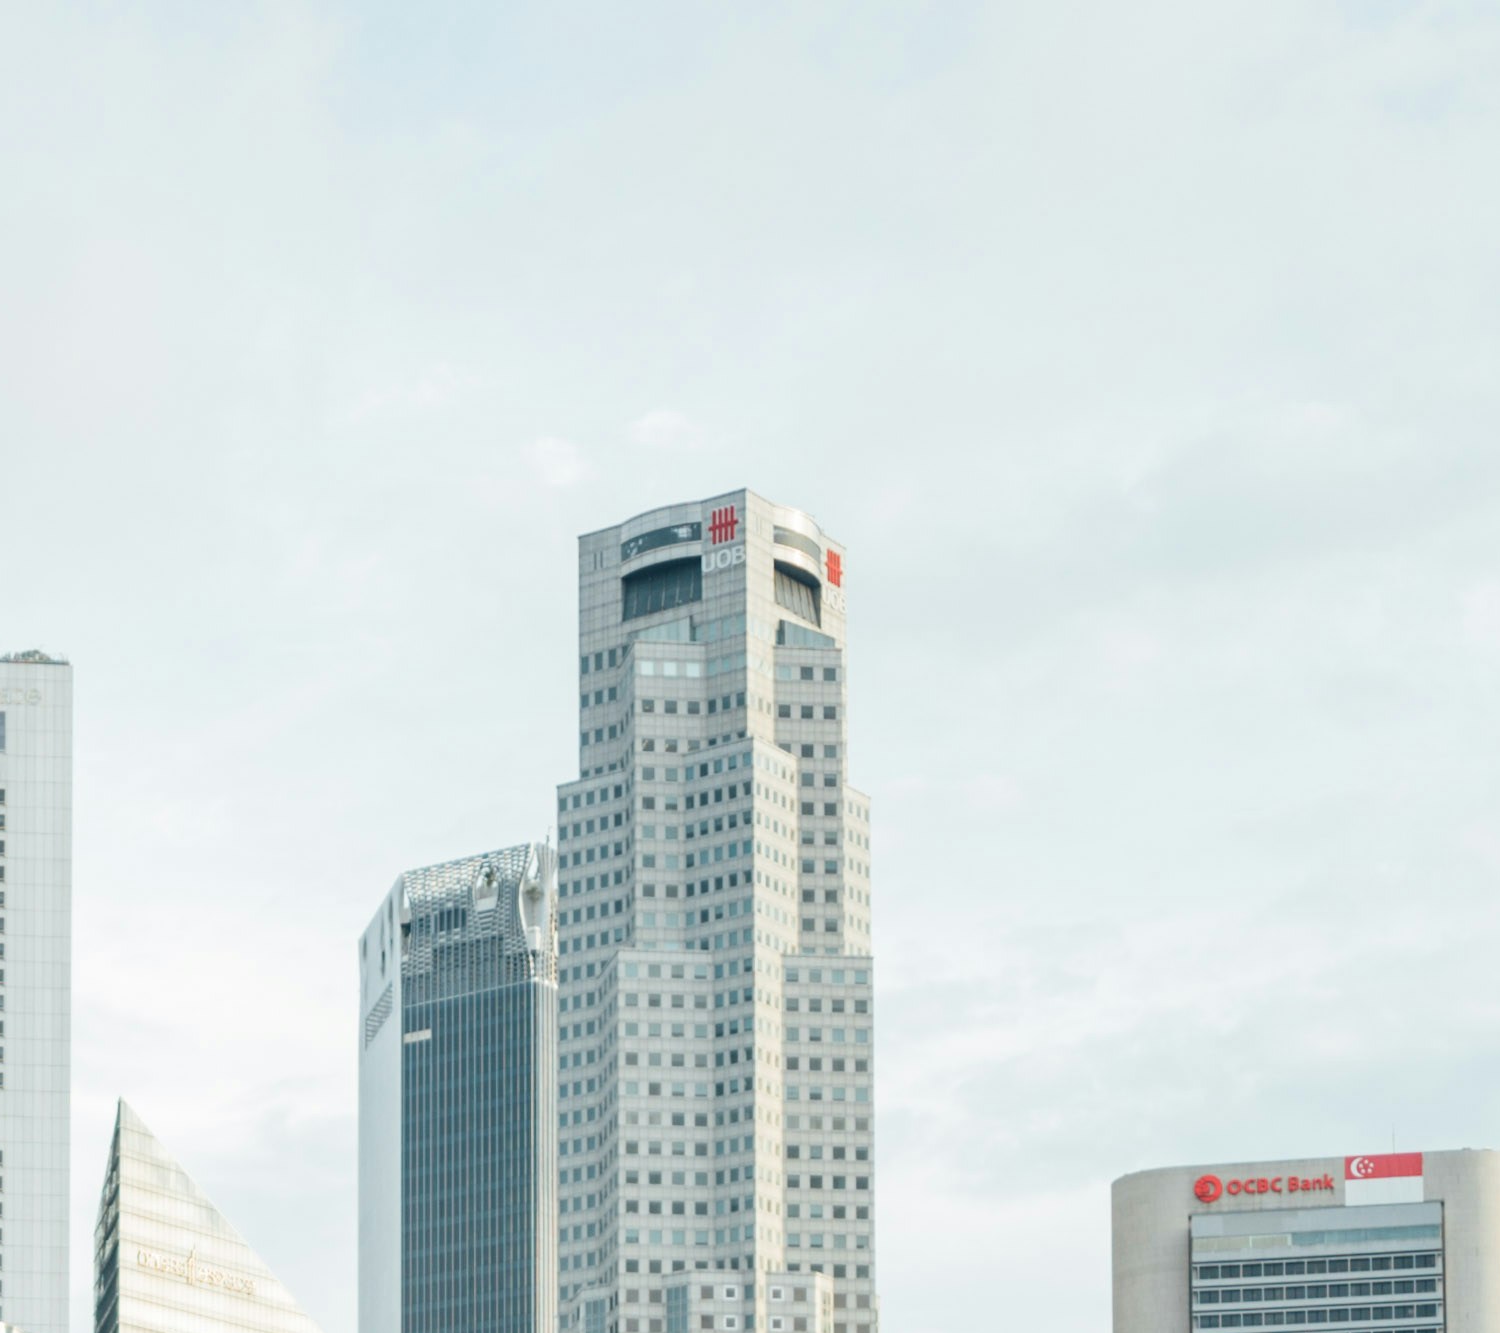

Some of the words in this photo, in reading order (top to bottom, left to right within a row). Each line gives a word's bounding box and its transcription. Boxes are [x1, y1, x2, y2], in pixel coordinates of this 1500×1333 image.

[702, 545, 746, 573] UOB
[823, 588, 847, 613] UOB
[1227, 1176, 1282, 1196] OCBC
[1288, 1173, 1334, 1193] Bank
